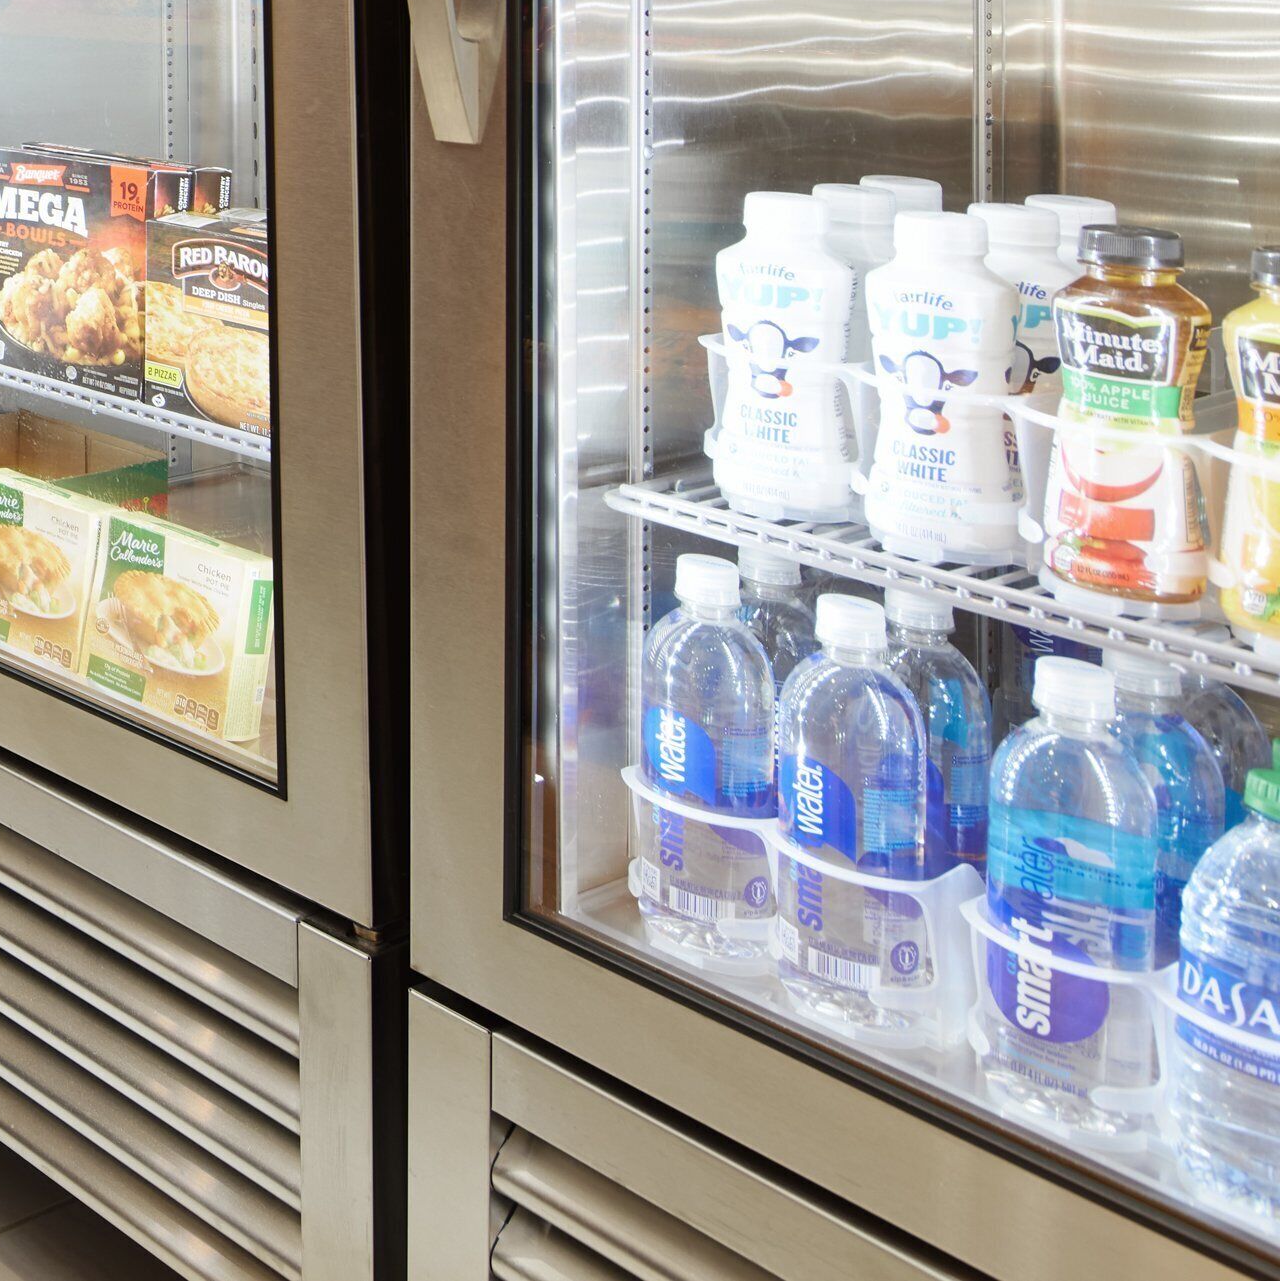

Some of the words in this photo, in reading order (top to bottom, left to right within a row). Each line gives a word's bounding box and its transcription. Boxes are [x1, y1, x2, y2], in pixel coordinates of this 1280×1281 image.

[15, 165, 61, 183] Banquet
[69, 177, 89, 186] 1953
[113, 200, 144, 213] PROTEIN
[5, 222, 67, 247] BOWLS
[0, 247, 23, 258] CHICKEN
[179, 247, 209, 269] RED
[192, 285, 216, 301] DEEP
[218, 290, 241, 306] DISH
[243, 300, 266, 312] Singles
[874, 301, 983, 344] YUP!
[1062, 319, 1163, 355] Minute
[1074, 344, 1142, 372] Maid
[154, 368, 177, 382] PIZZAS
[1083, 392, 1129, 410] JUICE
[1100, 383, 1151, 400] APPLE
[240, 422, 250, 431] NET
[740, 404, 798, 428] CLASSIC
[893, 440, 956, 467] CLASSIC
[897, 462, 948, 484] WHITE
[111, 530, 160, 556] Marie
[110, 544, 164, 569] Callender's
[197, 563, 232, 583] Chicken
[206, 576, 220, 587] POT
[220, 581, 230, 591] PIE
[794, 764, 824, 836] water.
[1011, 916, 1053, 1036] smart
